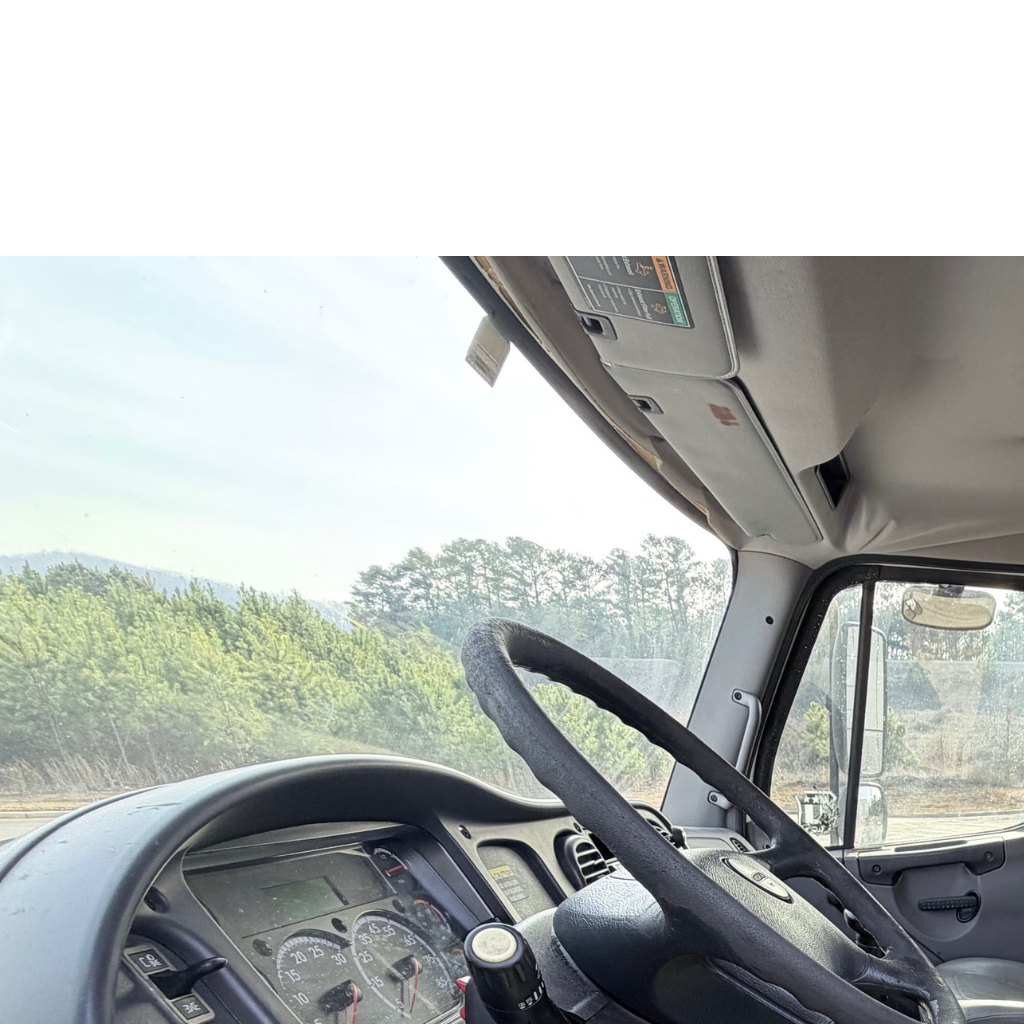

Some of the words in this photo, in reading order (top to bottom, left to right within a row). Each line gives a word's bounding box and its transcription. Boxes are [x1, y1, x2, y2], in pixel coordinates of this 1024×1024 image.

[658, 263, 673, 289] WARNING
[668, 296, 684, 324] OPERATION
[368, 922, 381, 934] 45
[383, 925, 396, 937] 55
[358, 933, 373, 945] 35
[404, 934, 416, 946] 65
[290, 951, 307, 965] 20
[308, 945, 324, 958] 25
[358, 950, 373, 963] 25
[331, 953, 347, 965] 30
[285, 969, 301, 982] 15
[371, 976, 384, 988] 15
[293, 992, 309, 1005] 10
